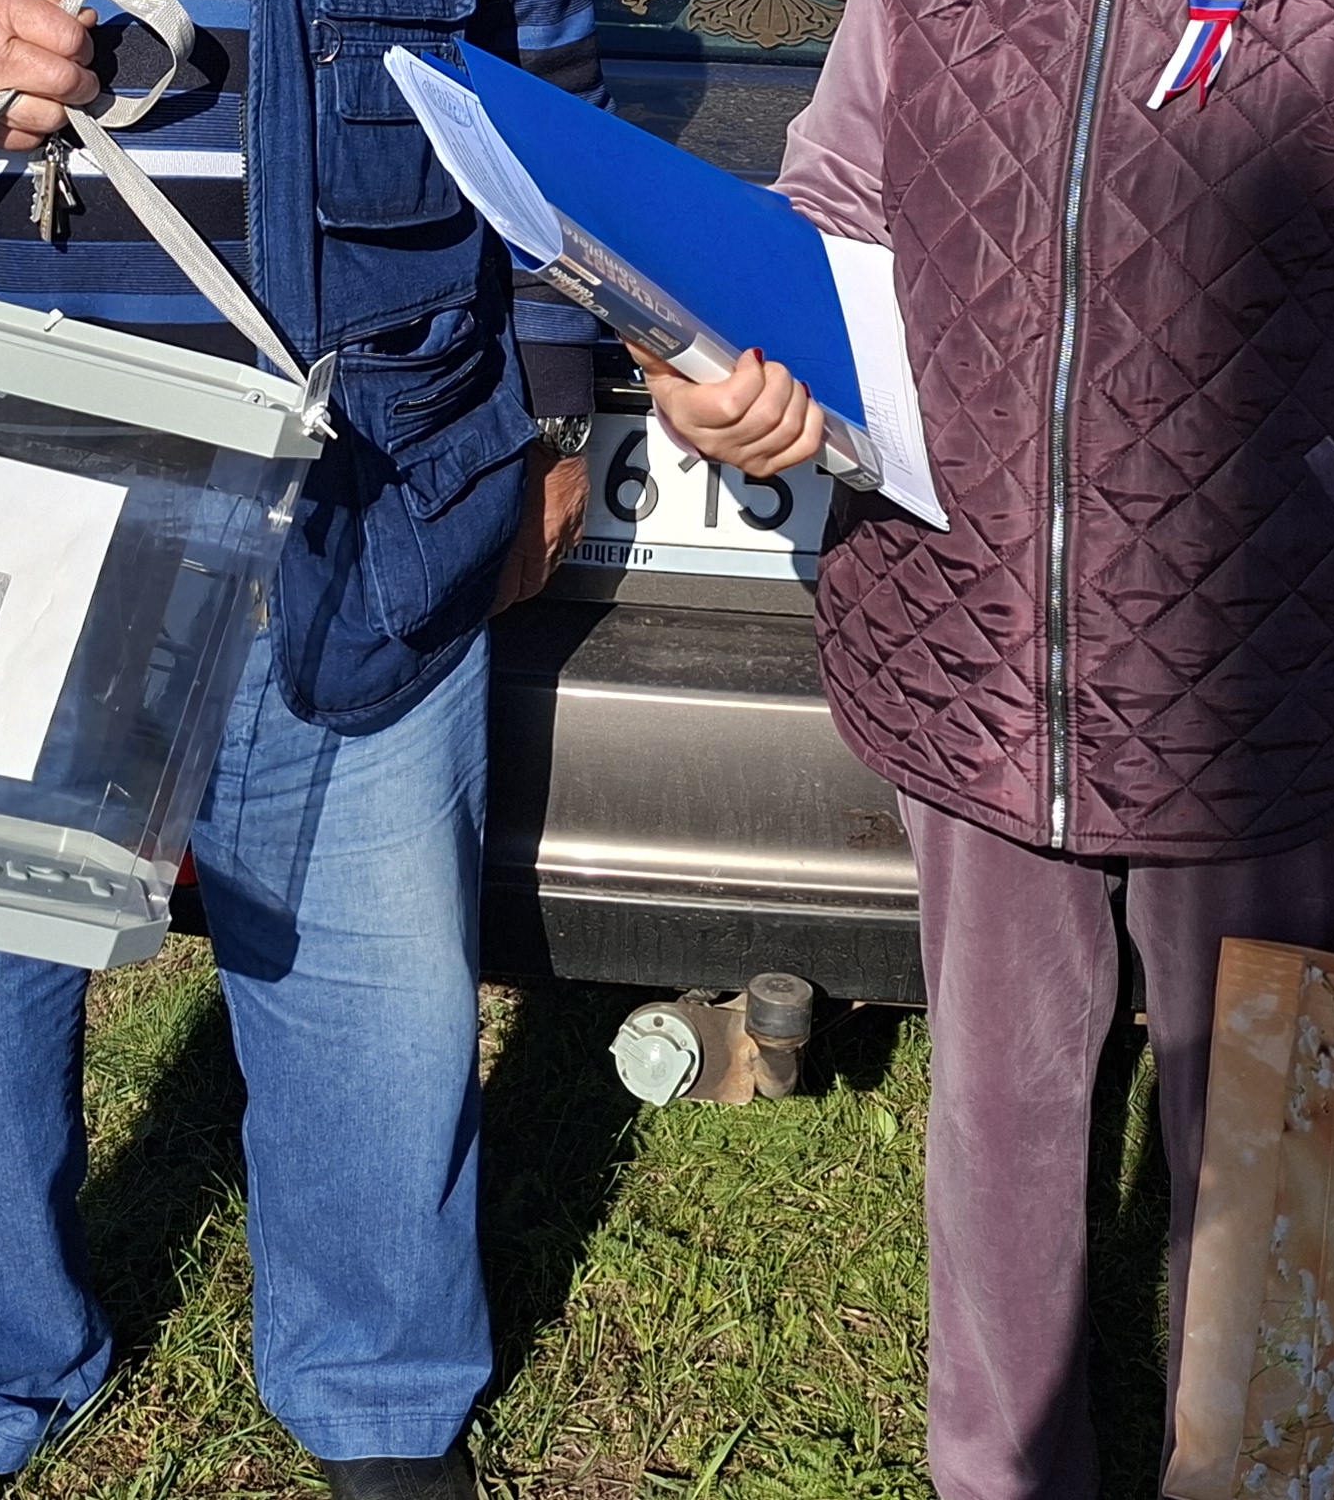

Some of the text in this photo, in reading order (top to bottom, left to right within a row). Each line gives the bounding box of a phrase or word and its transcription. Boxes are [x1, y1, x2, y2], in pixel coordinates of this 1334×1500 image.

[562, 223, 638, 285] complete
[548, 266, 595, 298] complete
[582, 250, 655, 311] EXPERT
[563, 542, 653, 565] ТОЦЕНТР
